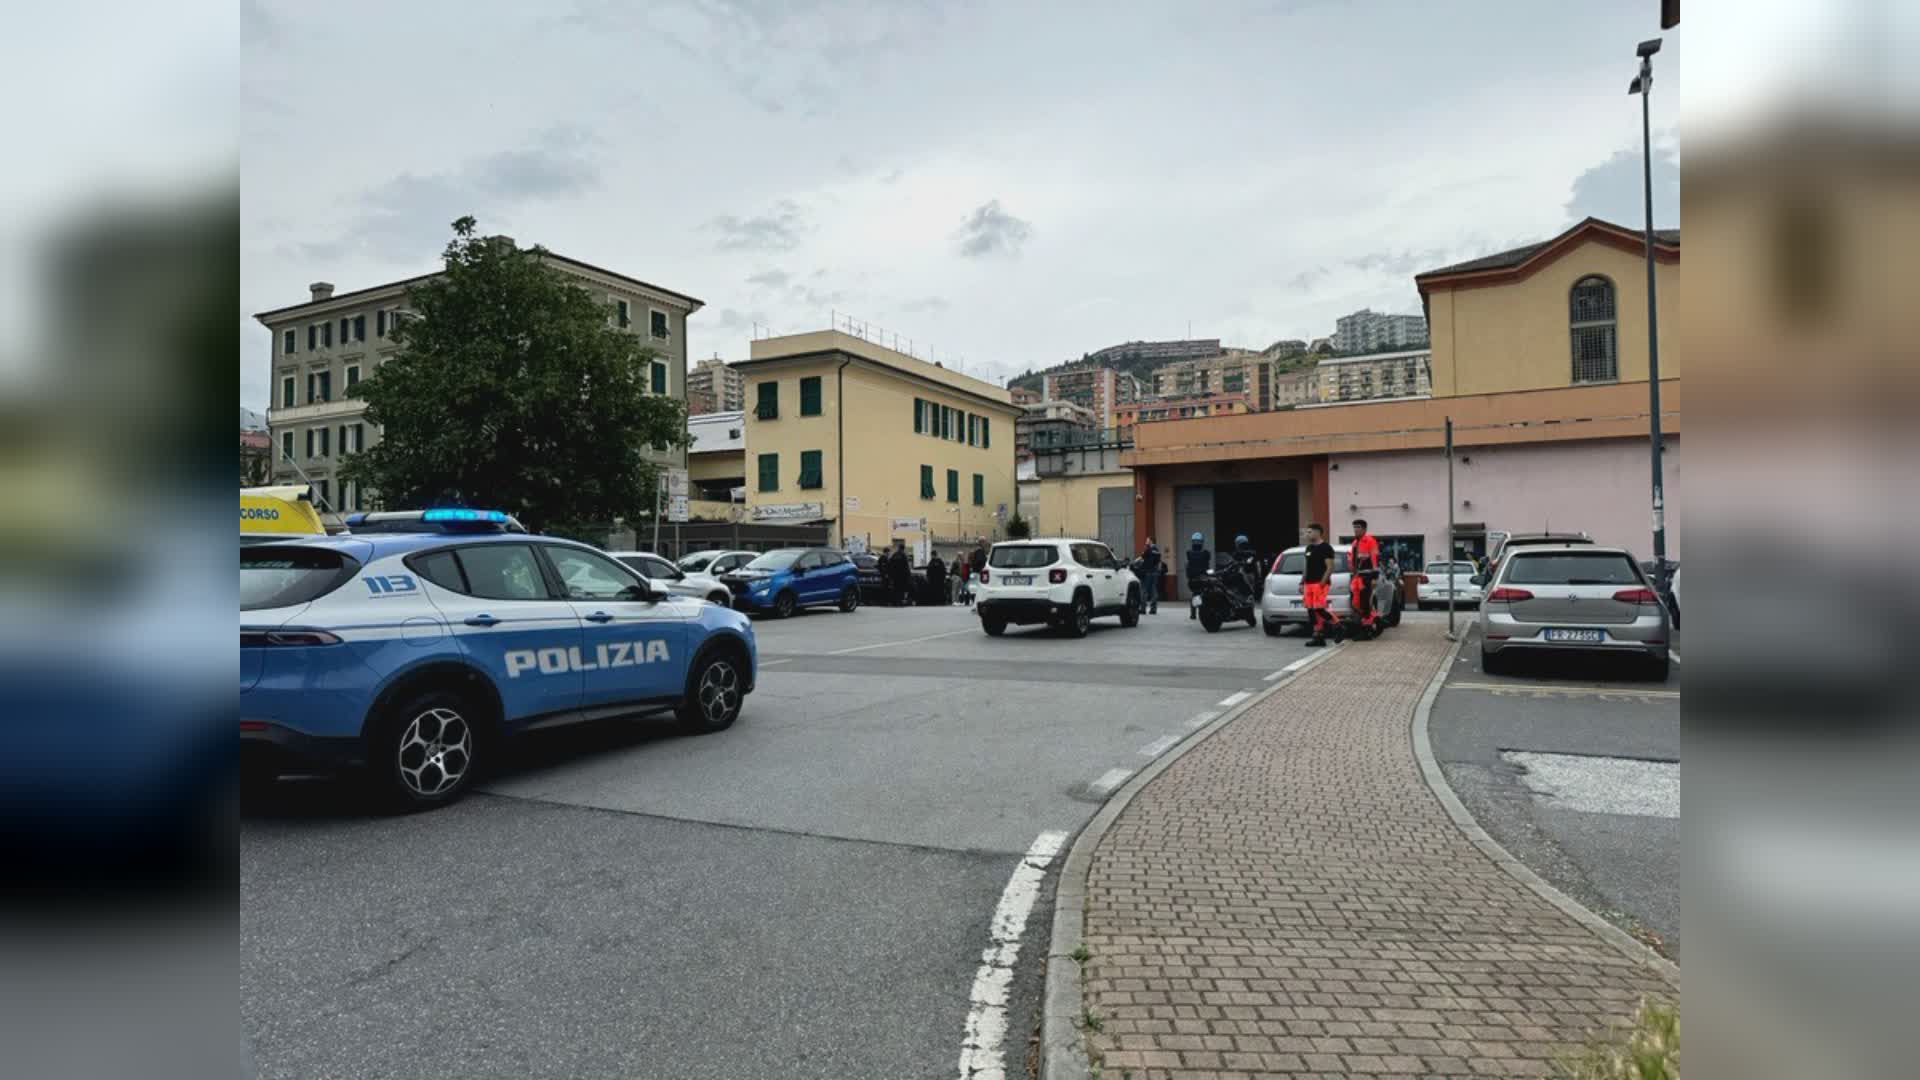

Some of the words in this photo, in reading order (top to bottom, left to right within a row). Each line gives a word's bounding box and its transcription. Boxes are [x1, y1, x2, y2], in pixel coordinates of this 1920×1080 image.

[240, 507, 280, 521] CORSO
[361, 574, 417, 594] 113
[504, 639, 671, 679] POLIZIA
